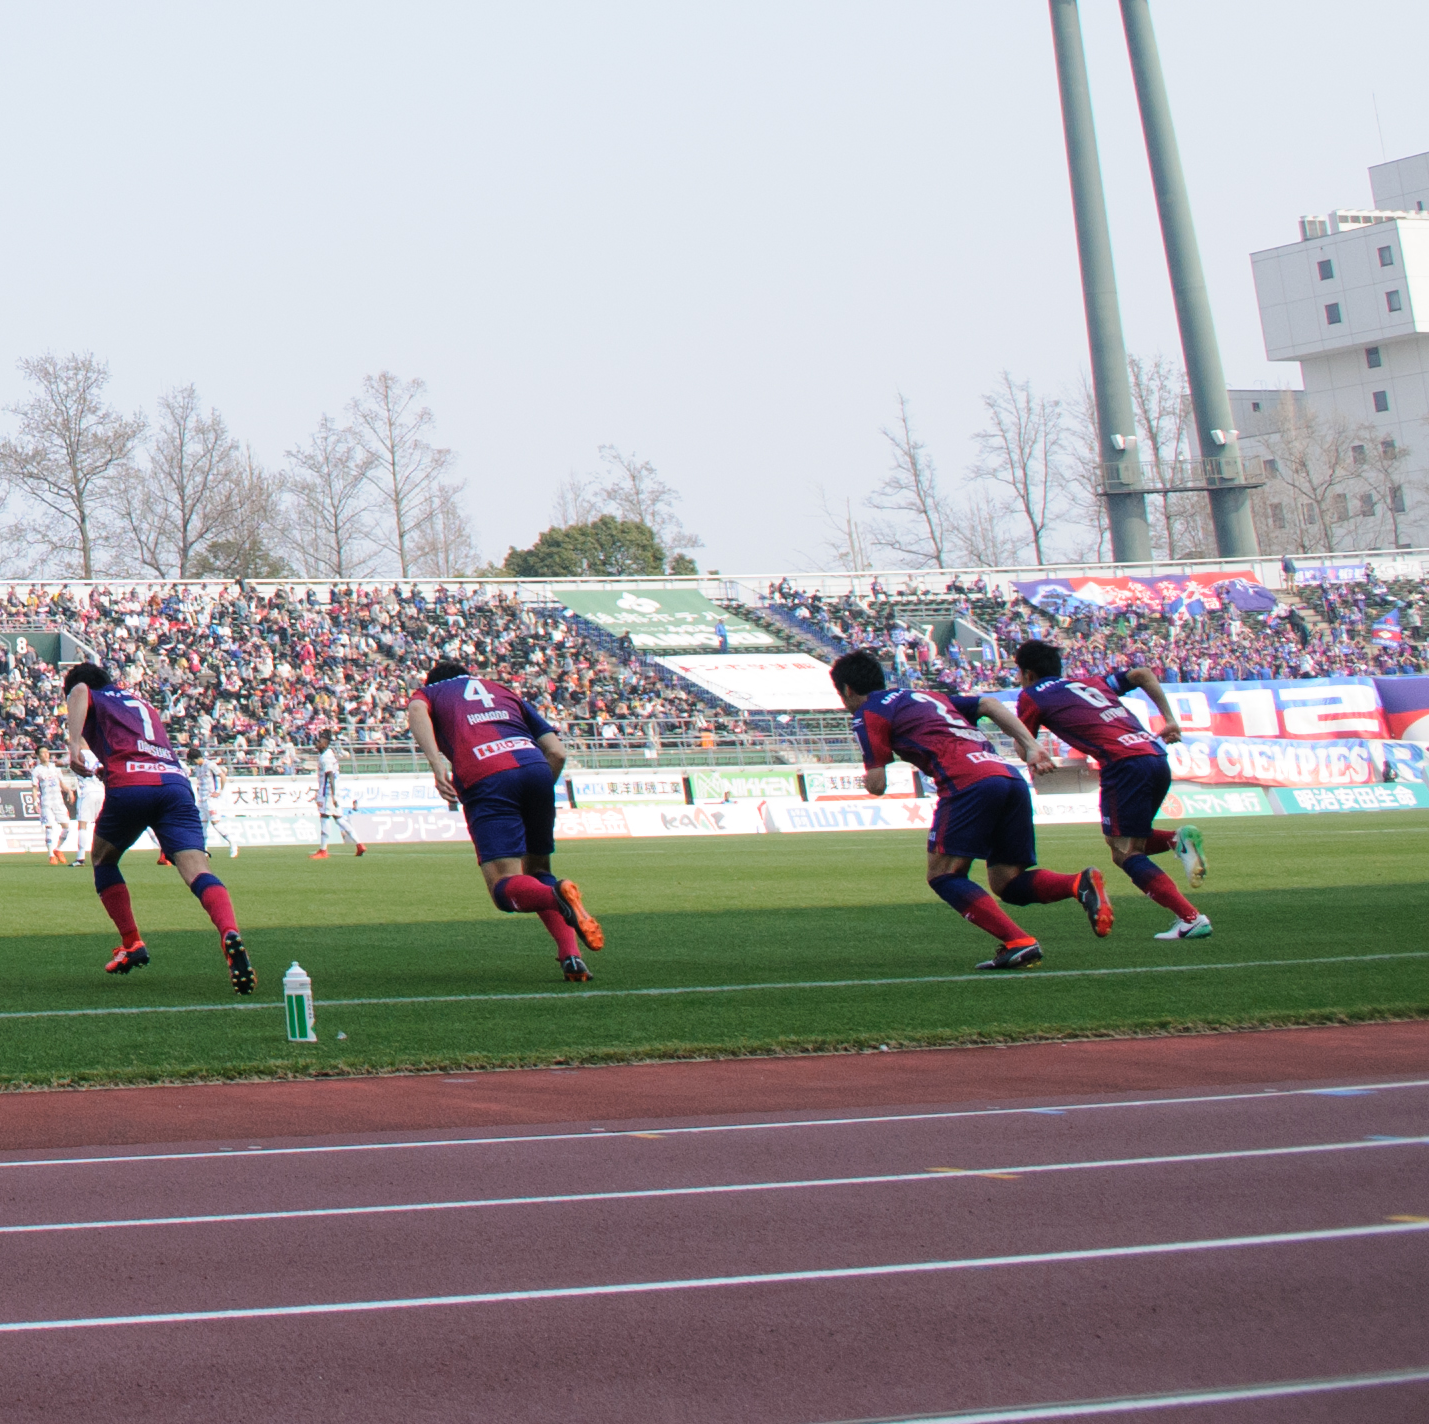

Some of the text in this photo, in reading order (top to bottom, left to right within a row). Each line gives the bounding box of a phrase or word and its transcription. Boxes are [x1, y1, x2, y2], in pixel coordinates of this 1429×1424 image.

[16, 637, 28, 654] 8
[463, 679, 495, 708] 4
[123, 700, 155, 741] 7
[1167, 741, 1211, 777] OS
[1216, 742, 1370, 784] CIEMPIES
[607, 780, 682, 796] 東洋重機工業
[727, 776, 795, 797] NIKKEN
[1293, 785, 1418, 811] 明治安田生命
[1182, 790, 1263, 814] トマト銀行
[786, 804, 892, 829] 岡山ガス
